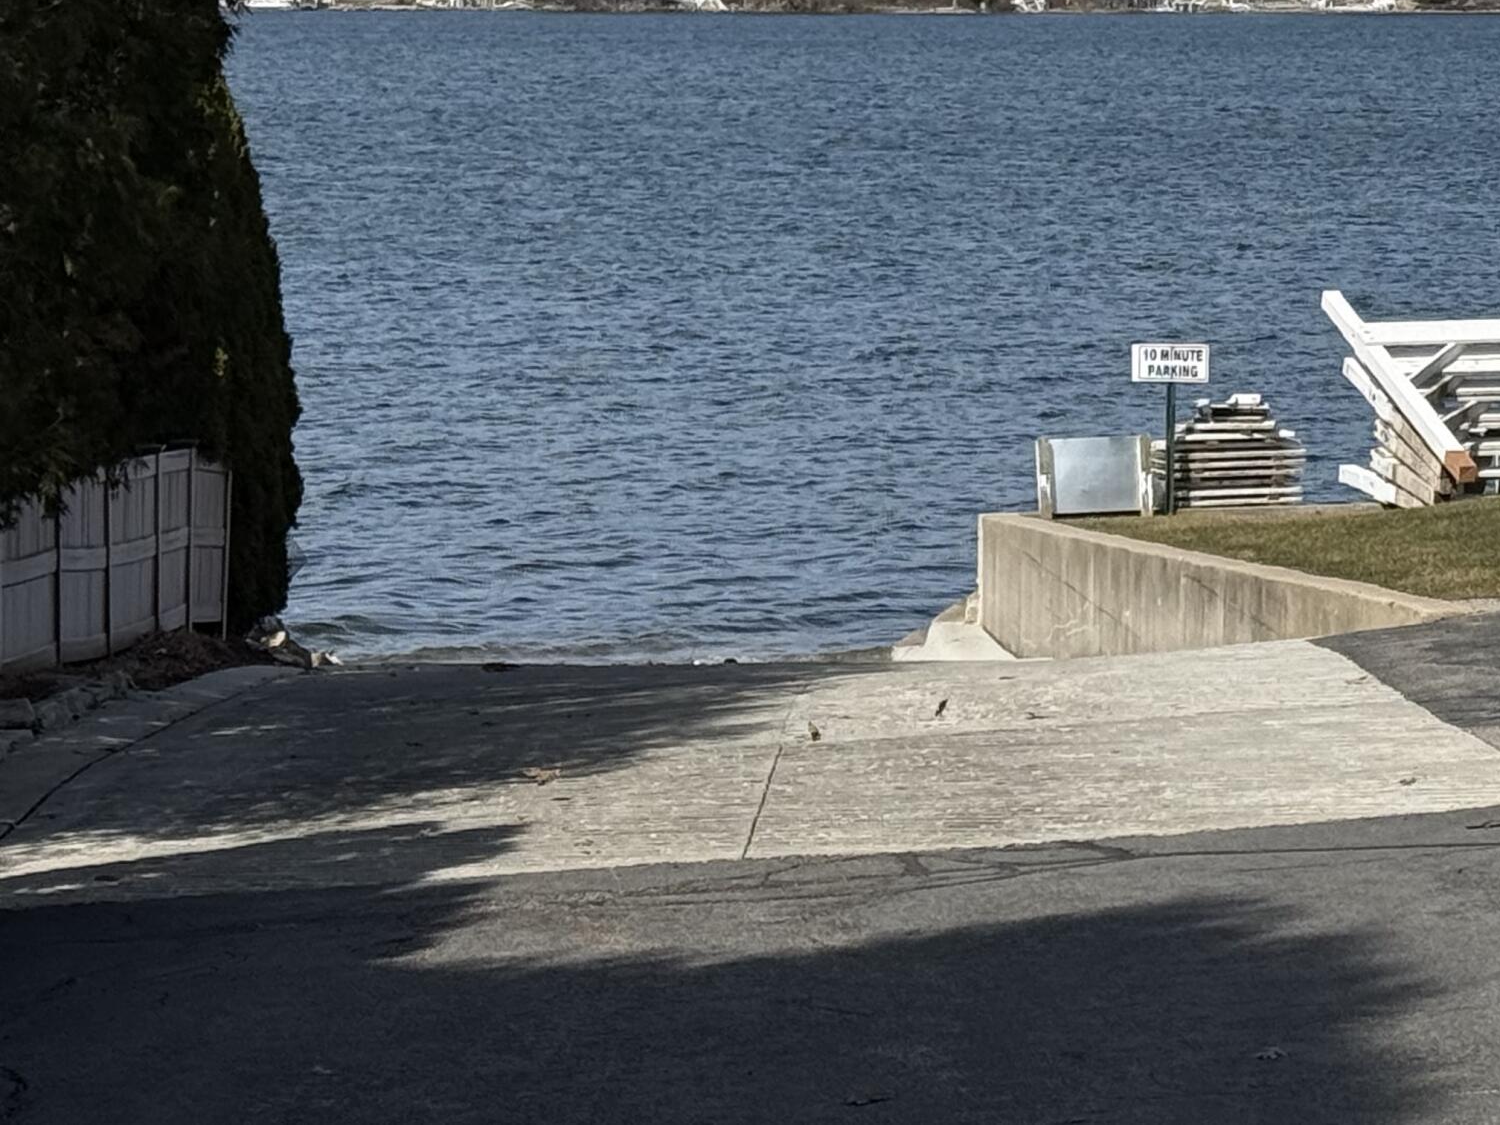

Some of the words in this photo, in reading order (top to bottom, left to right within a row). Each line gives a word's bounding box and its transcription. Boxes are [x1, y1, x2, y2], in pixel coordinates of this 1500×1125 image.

[1143, 348, 1157, 361] 10
[1160, 349, 1204, 362] MINUTE
[1147, 364, 1198, 378] PARKING
